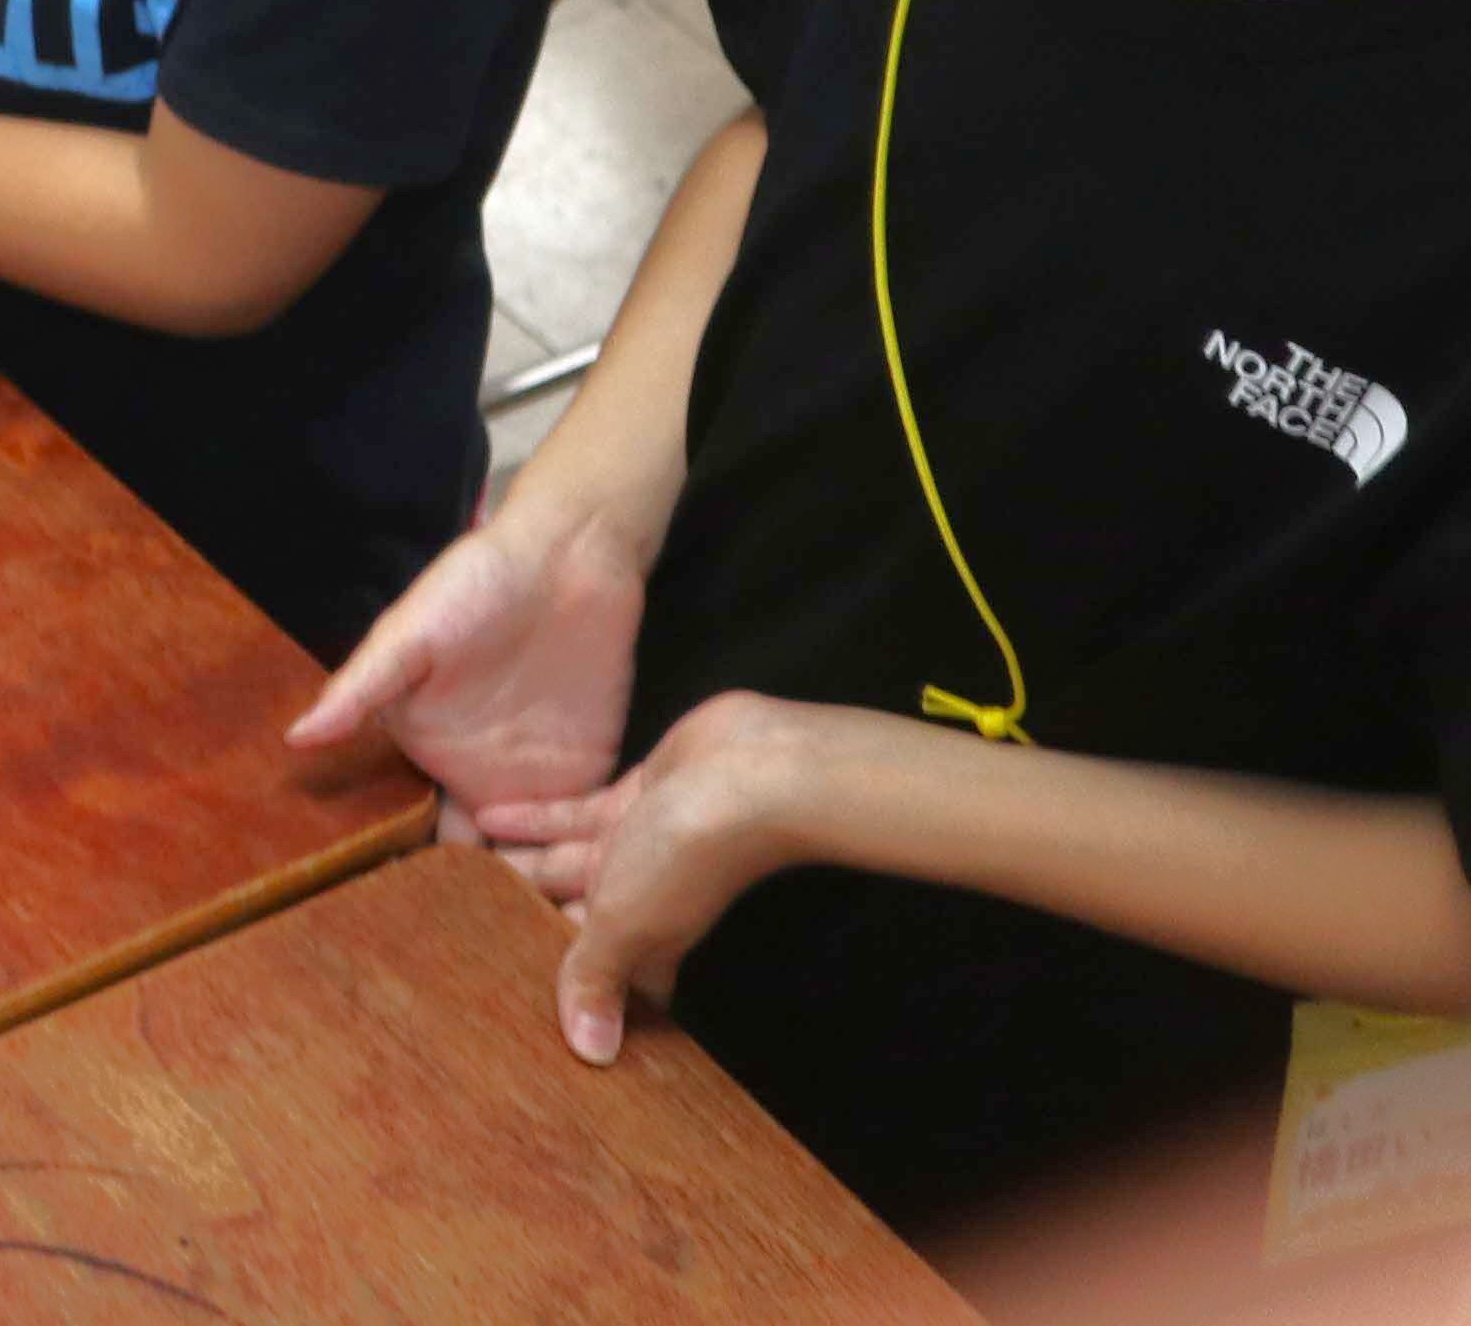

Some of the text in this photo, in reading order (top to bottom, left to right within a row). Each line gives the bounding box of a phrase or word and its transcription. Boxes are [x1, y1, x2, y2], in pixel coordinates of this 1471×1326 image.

[1203, 328, 1358, 428] NORTH
[1285, 340, 1369, 402] THE
[1227, 375, 1340, 451] FACE
